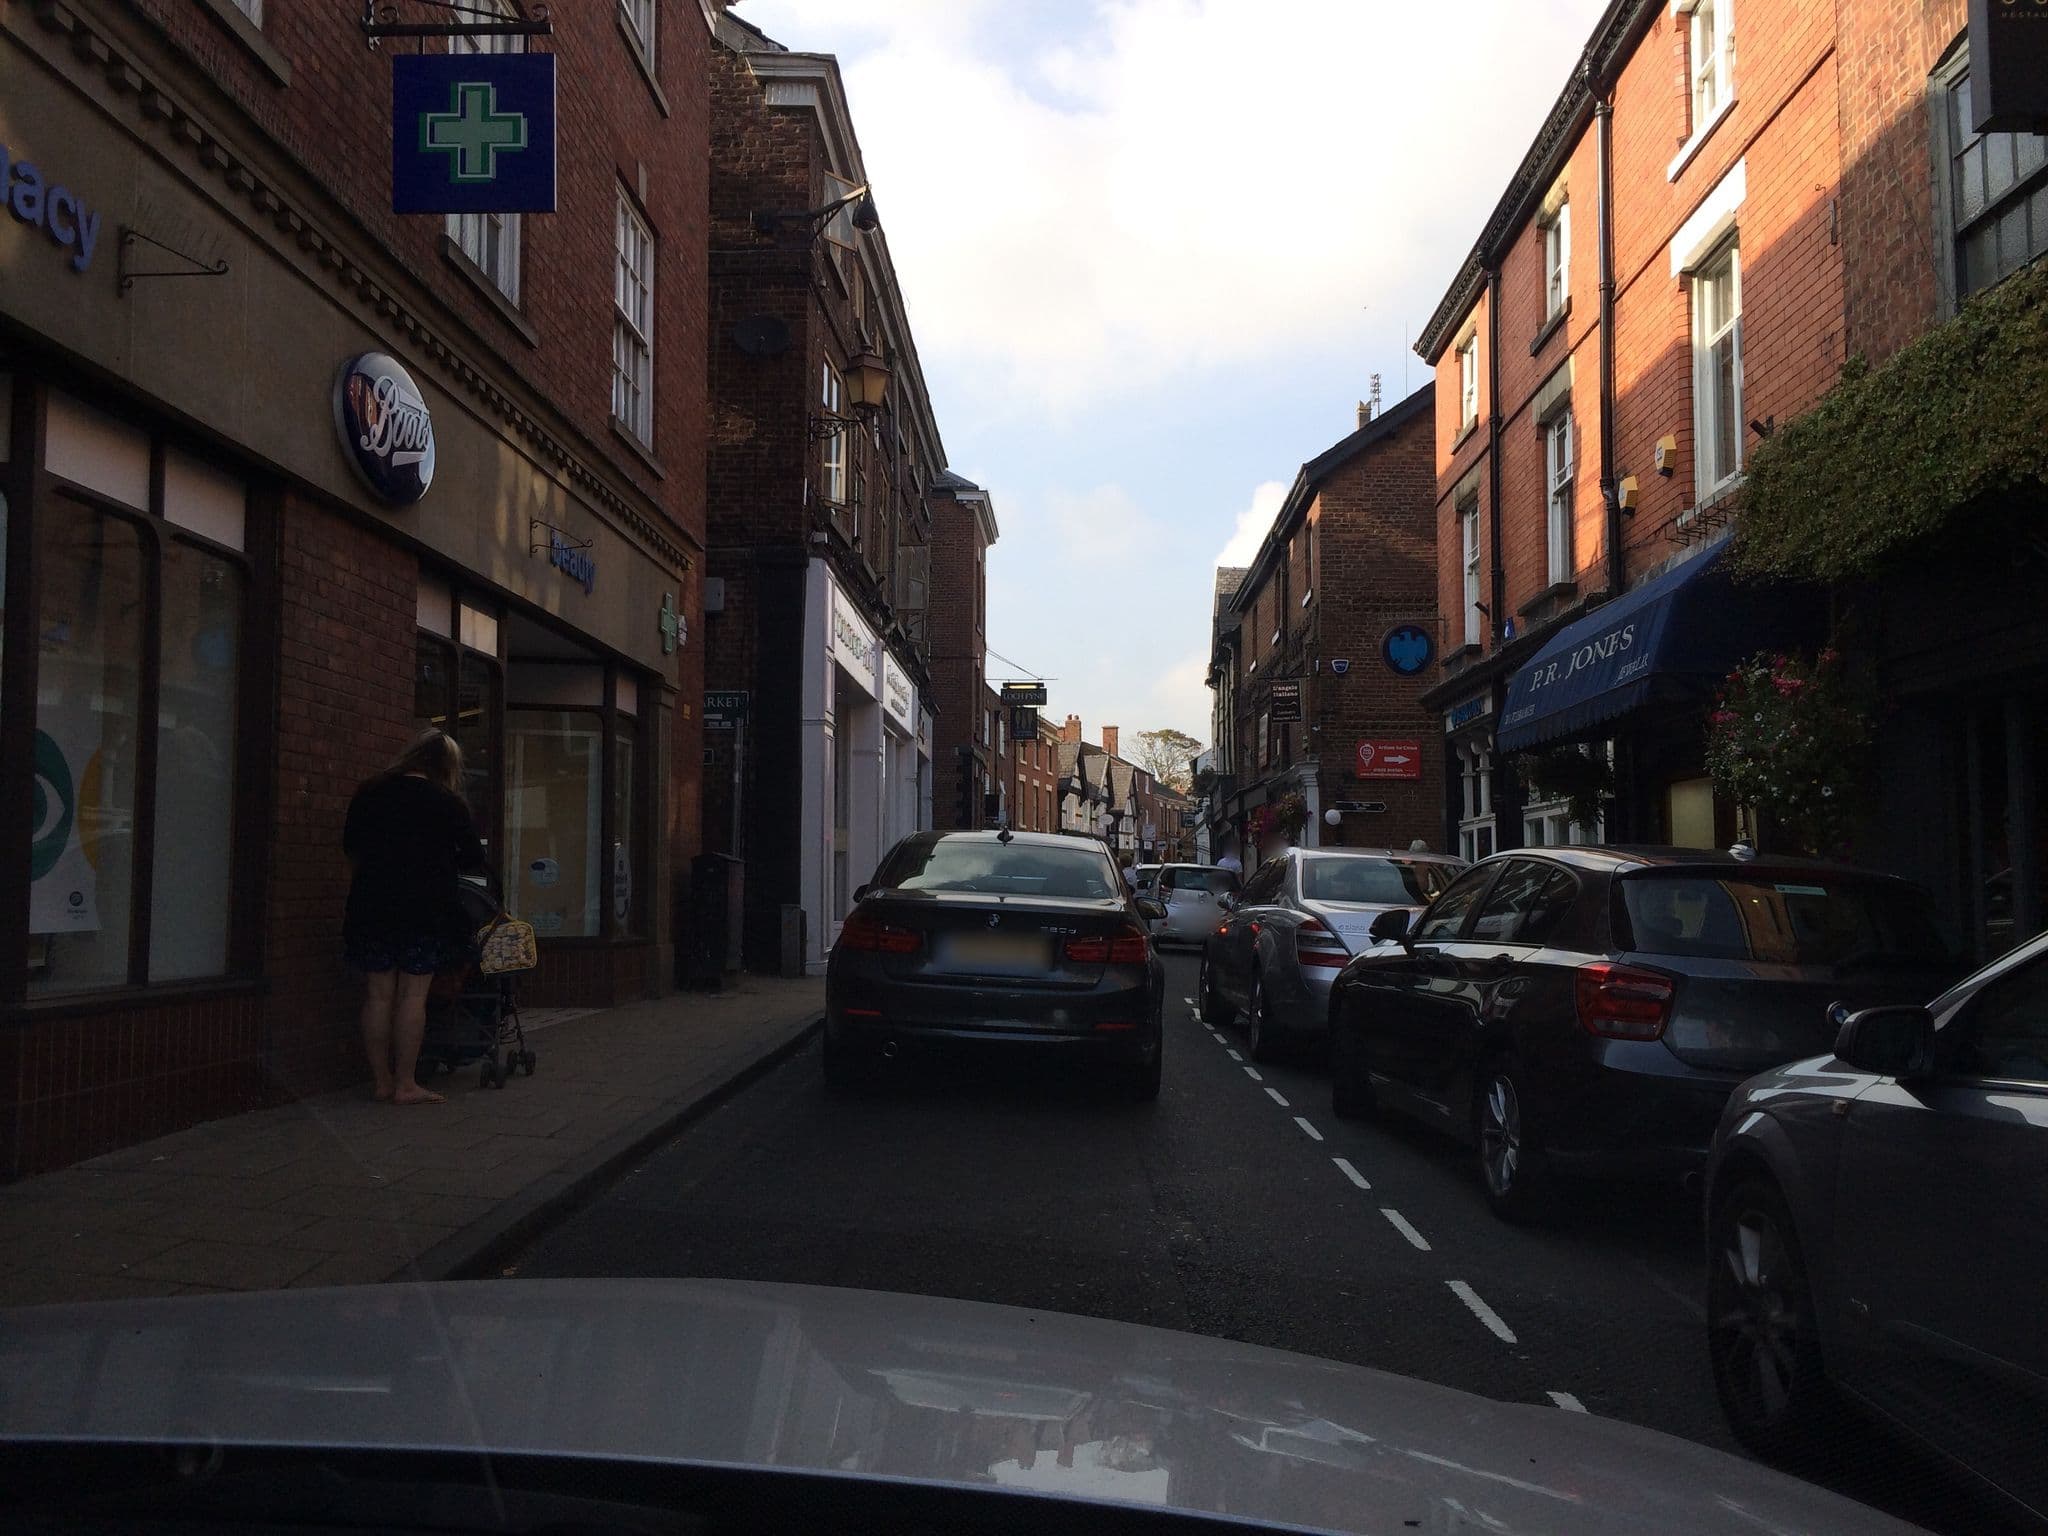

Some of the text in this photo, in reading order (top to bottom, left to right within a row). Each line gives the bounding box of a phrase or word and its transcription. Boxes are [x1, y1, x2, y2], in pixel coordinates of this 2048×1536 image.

[360, 375, 430, 458] Boots
[551, 529, 595, 596] beauty
[1529, 624, 1636, 692] P.R. JONES
